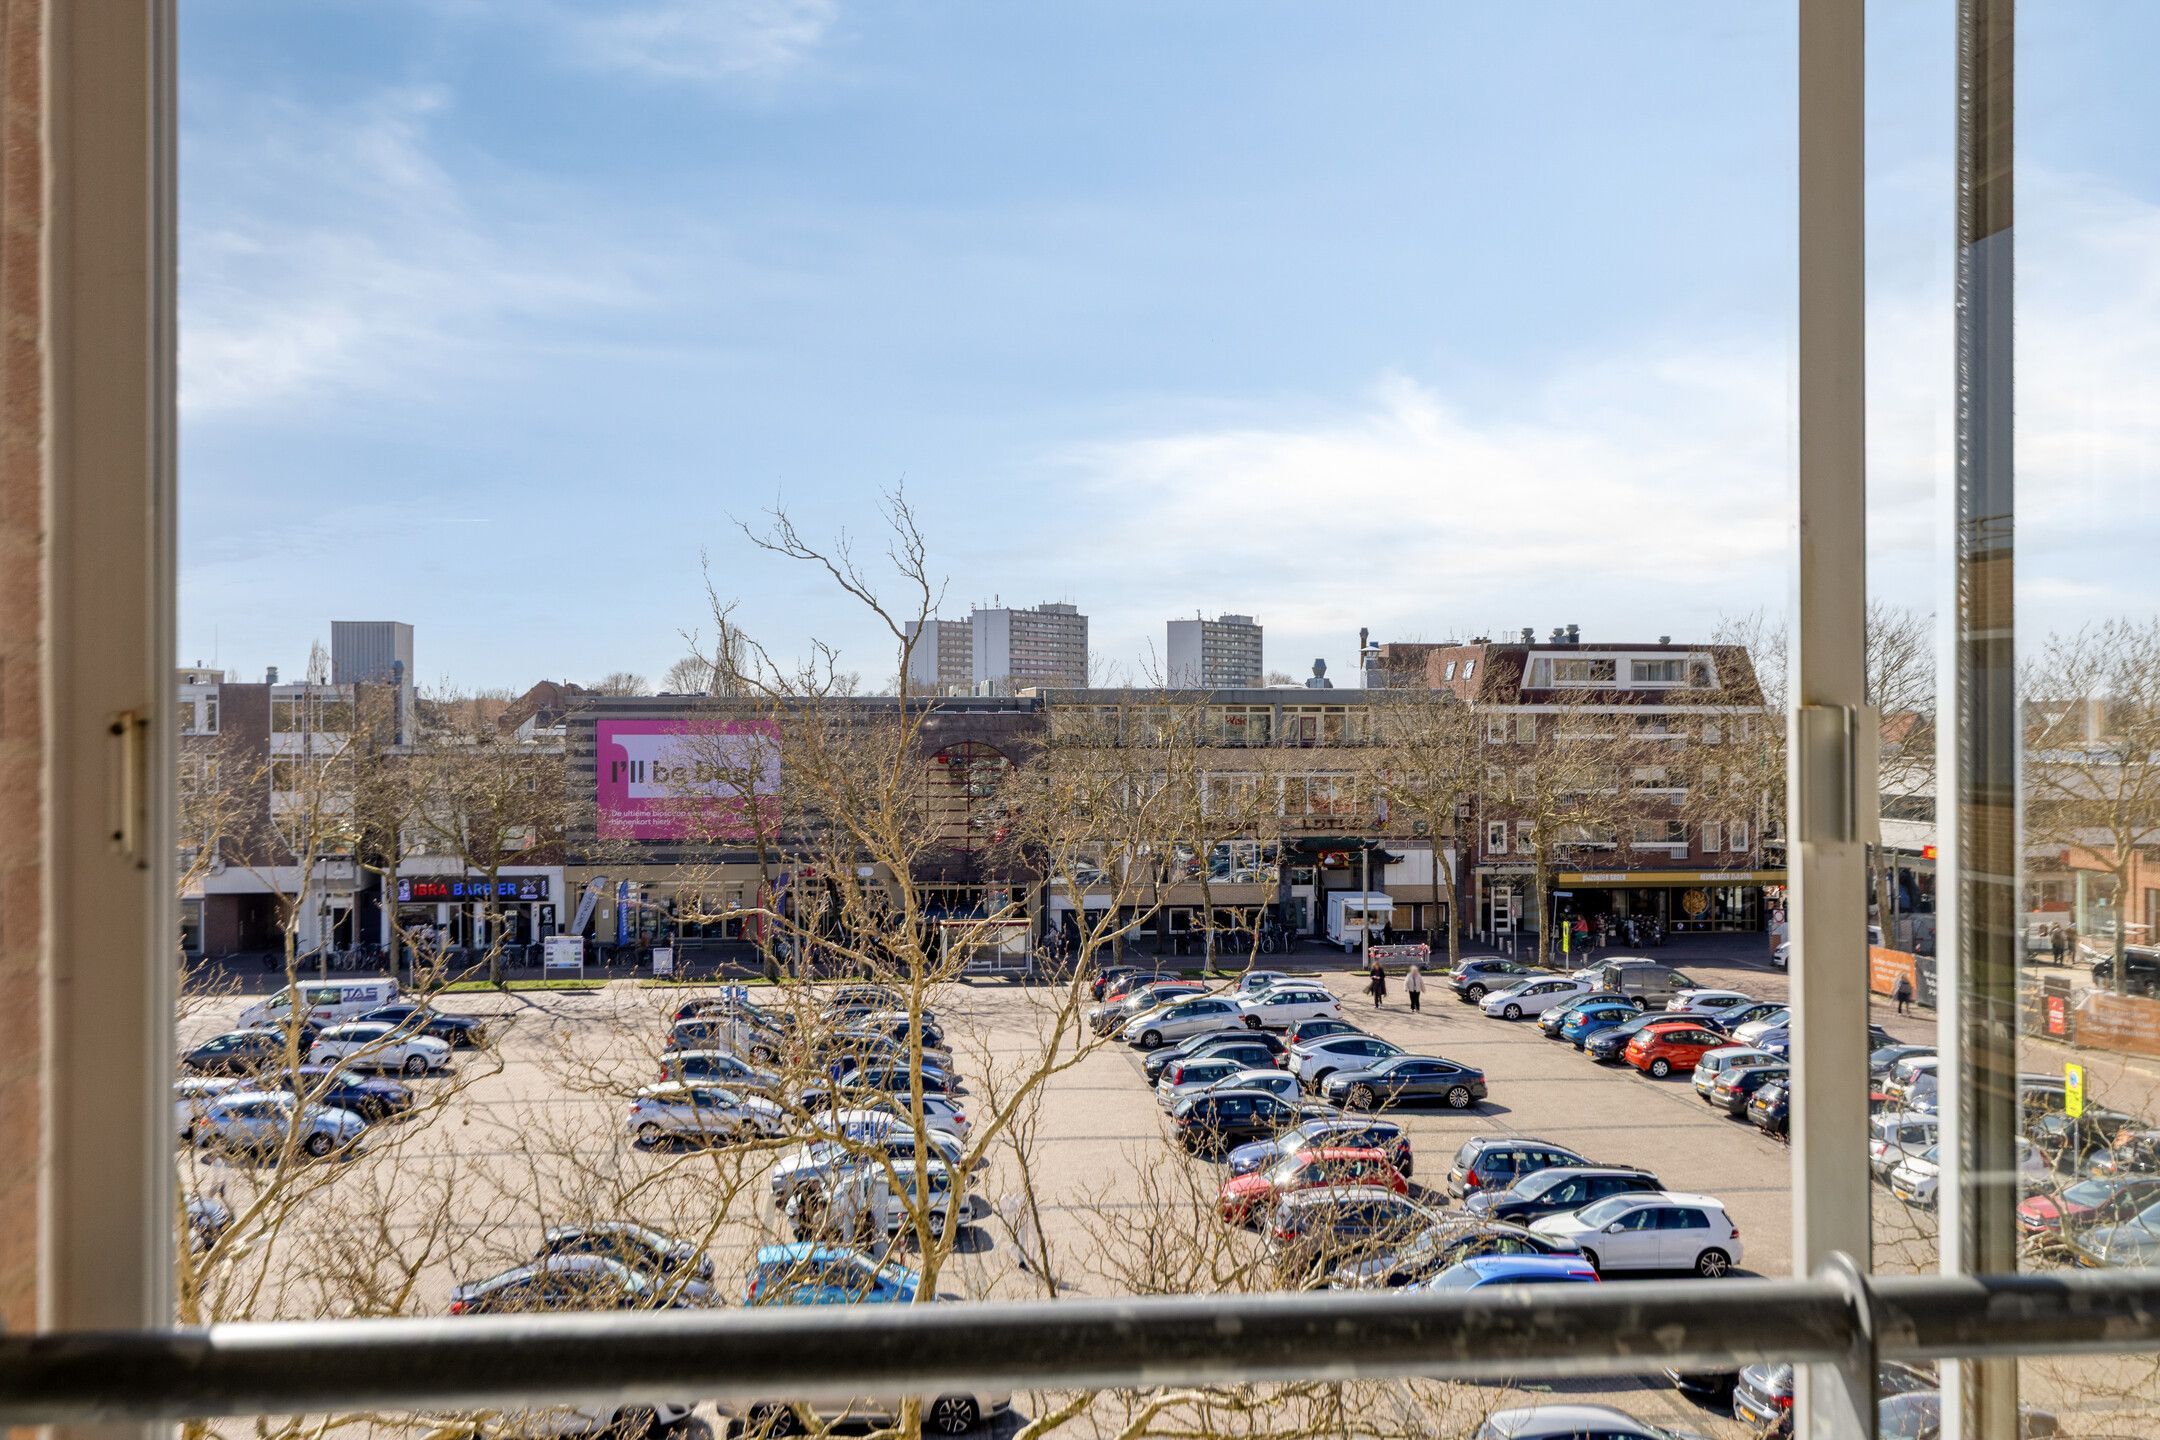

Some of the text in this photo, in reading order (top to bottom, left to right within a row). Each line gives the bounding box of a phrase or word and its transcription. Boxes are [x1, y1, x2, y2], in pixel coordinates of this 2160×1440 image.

[612, 761, 644, 783] I'll
[653, 760, 688, 784] be
[652, 809, 687, 818] bioscop
[413, 883, 448, 896] IBRA
[343, 987, 378, 998] TAS
